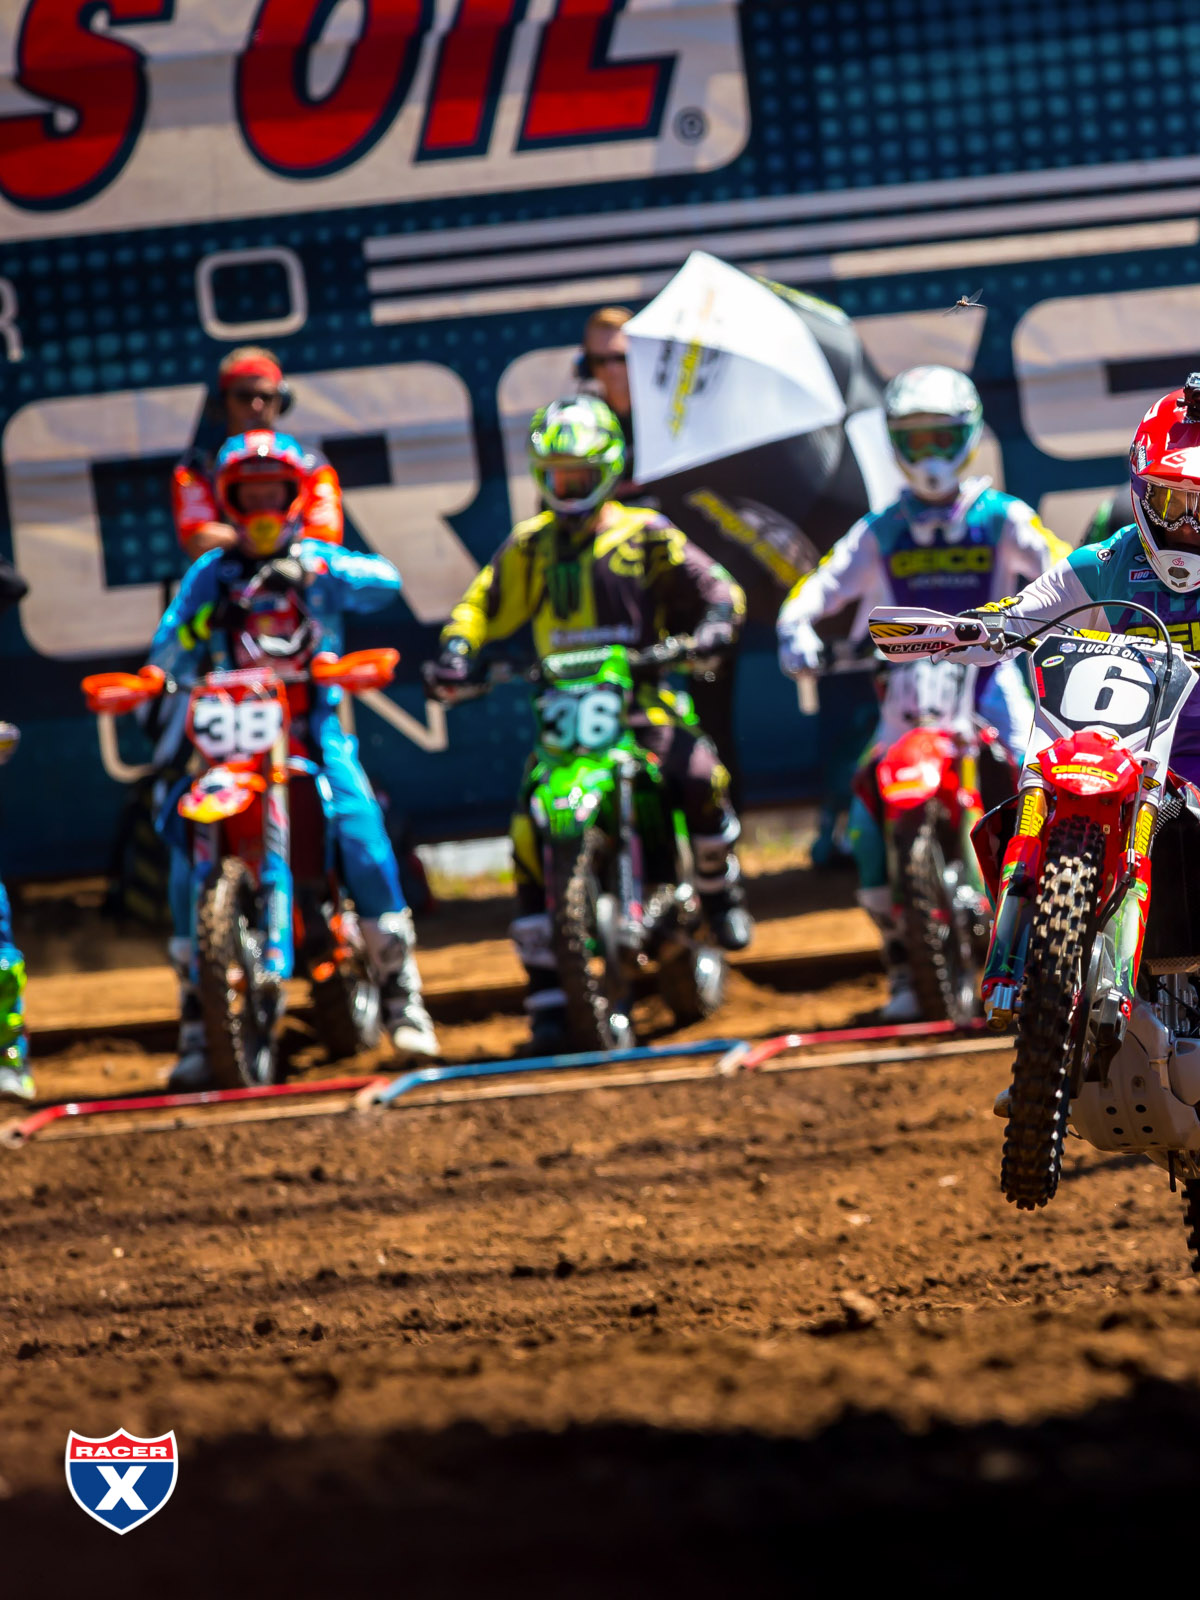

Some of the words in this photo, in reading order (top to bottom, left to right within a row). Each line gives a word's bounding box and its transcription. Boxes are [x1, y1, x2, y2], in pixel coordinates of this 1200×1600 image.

[891, 546, 991, 578] GEICO
[890, 641, 942, 653] CYCRA
[1077, 643, 1120, 655] LUCAS
[1060, 655, 1151, 726] 6
[193, 695, 282, 758] 38
[543, 690, 622, 751] 36
[1051, 764, 1118, 783] GEICO
[1056, 773, 1112, 788] HONDA
